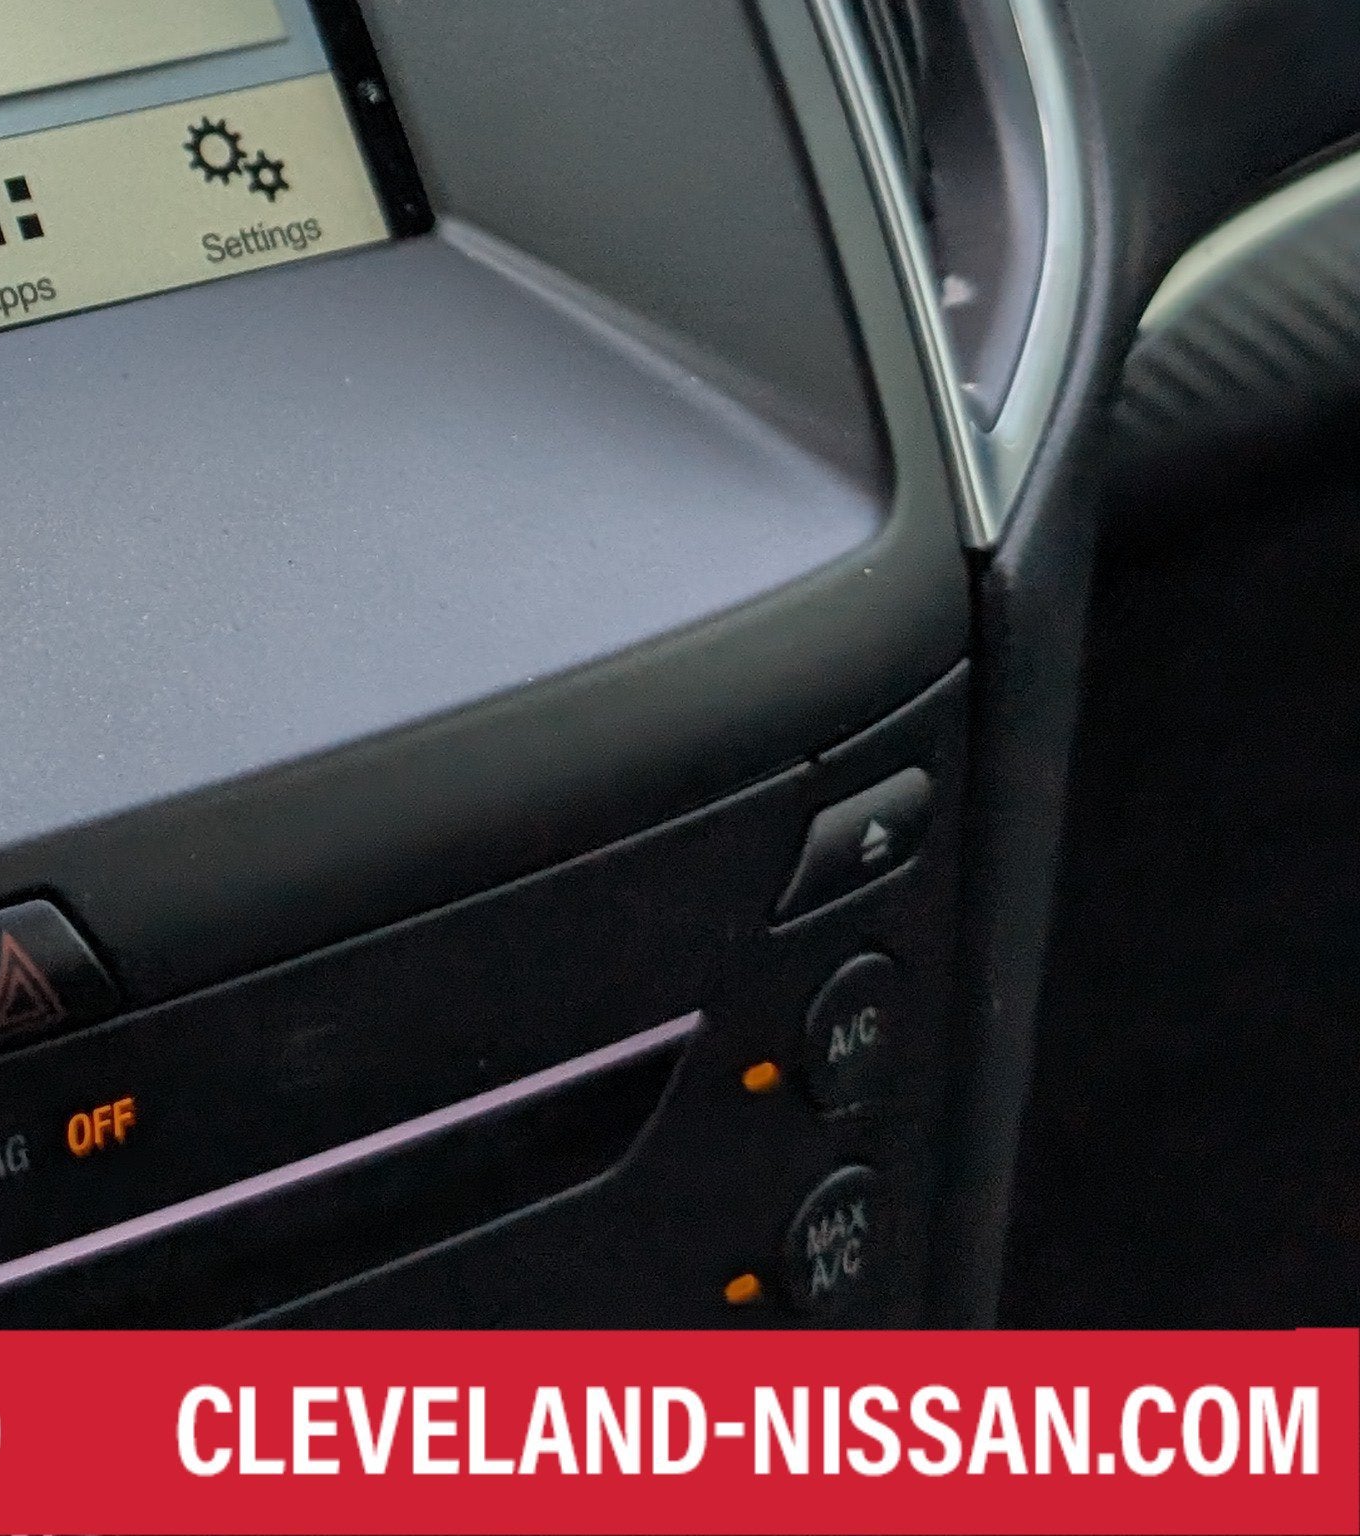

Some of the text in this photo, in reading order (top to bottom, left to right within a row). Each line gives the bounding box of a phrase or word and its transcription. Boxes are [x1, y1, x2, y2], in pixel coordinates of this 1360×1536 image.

[201, 215, 323, 265] Settings
[829, 1006, 877, 1062] A/C
[67, 1097, 135, 1155] OFF
[807, 1202, 867, 1259] MAX
[812, 1238, 860, 1295] A/C
